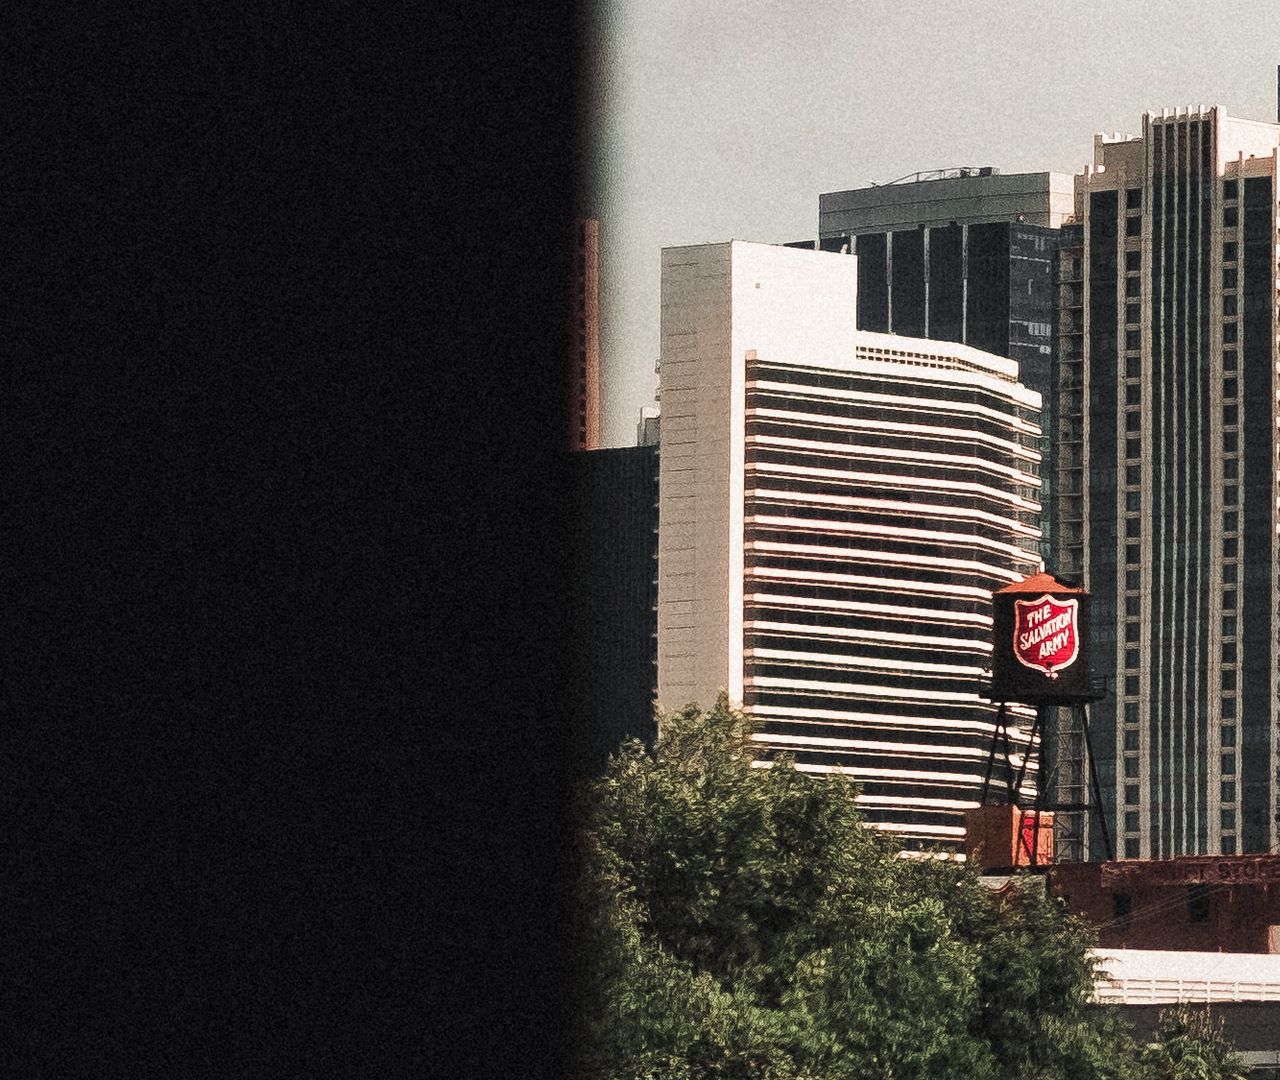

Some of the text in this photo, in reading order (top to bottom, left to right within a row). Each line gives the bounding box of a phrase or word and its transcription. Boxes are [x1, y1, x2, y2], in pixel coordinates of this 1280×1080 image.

[1020, 608, 1072, 650] SALVATION
[1027, 604, 1051, 628] THE
[1039, 630, 1069, 659] ARMY
